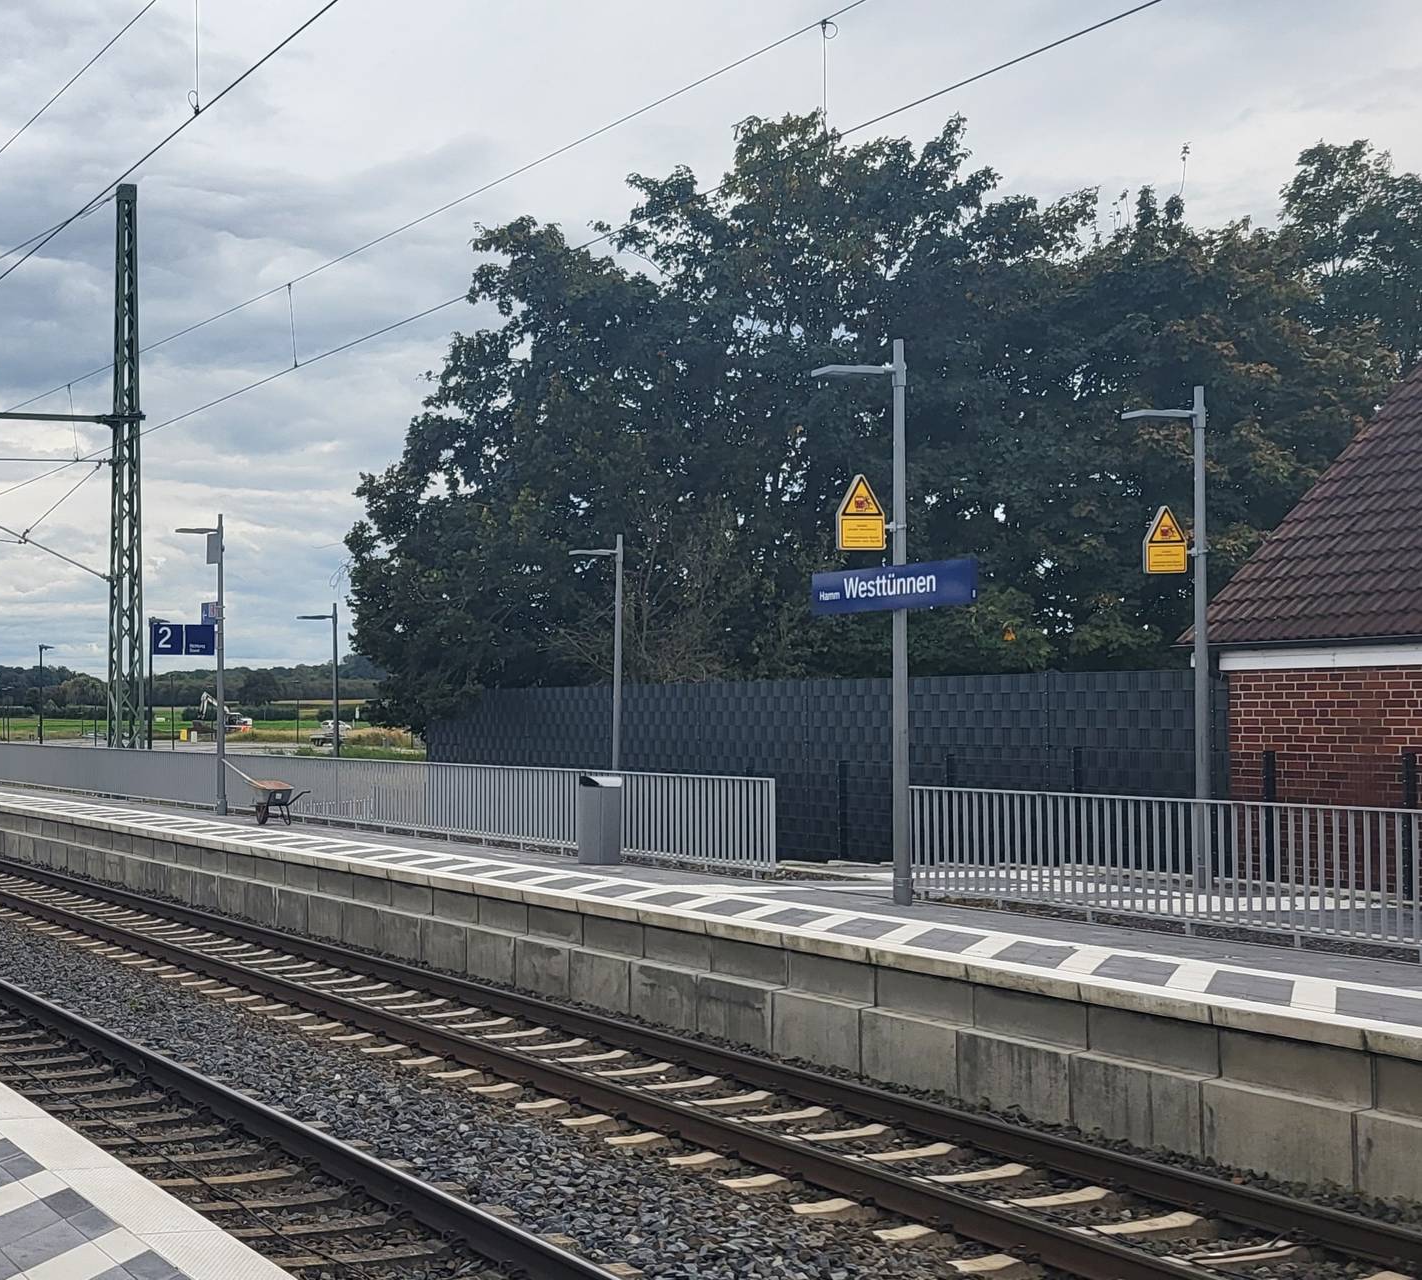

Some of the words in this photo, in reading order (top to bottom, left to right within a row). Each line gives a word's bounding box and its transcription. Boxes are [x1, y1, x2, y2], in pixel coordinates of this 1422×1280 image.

[819, 591, 841, 601] Hamm
[843, 573, 937, 599] Westtünnen
[158, 626, 172, 648] 2
